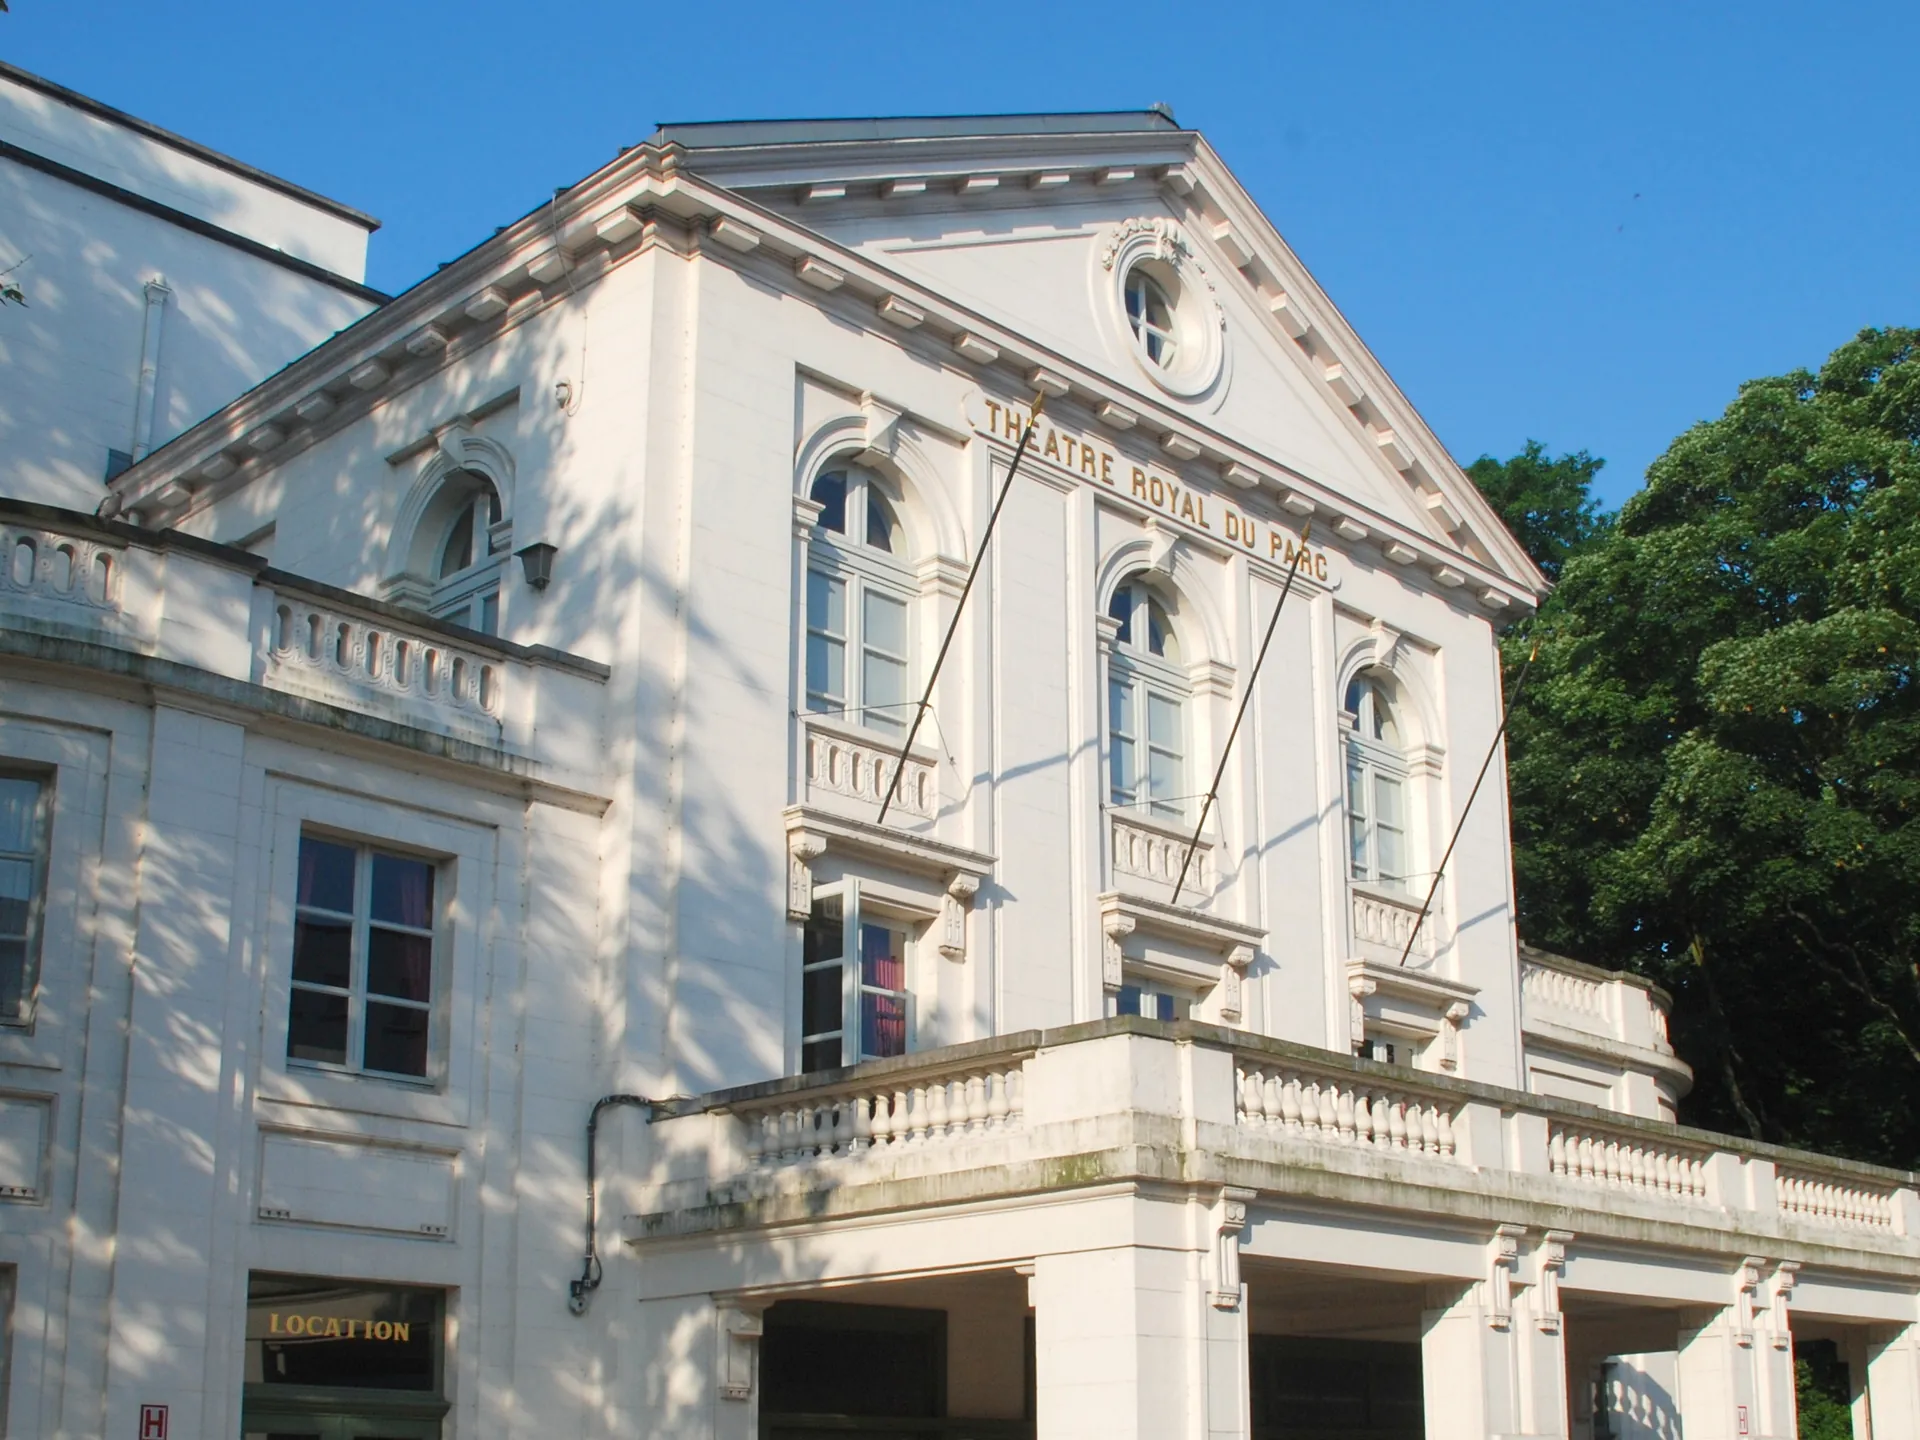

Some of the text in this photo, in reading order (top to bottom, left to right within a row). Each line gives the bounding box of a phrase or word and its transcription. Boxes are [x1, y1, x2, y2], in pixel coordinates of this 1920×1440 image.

[985, 399, 1328, 581] THEATRE ROYAL DU PARC
[269, 1313, 411, 1342] LOCATION
[144, 1408, 165, 1438] H
